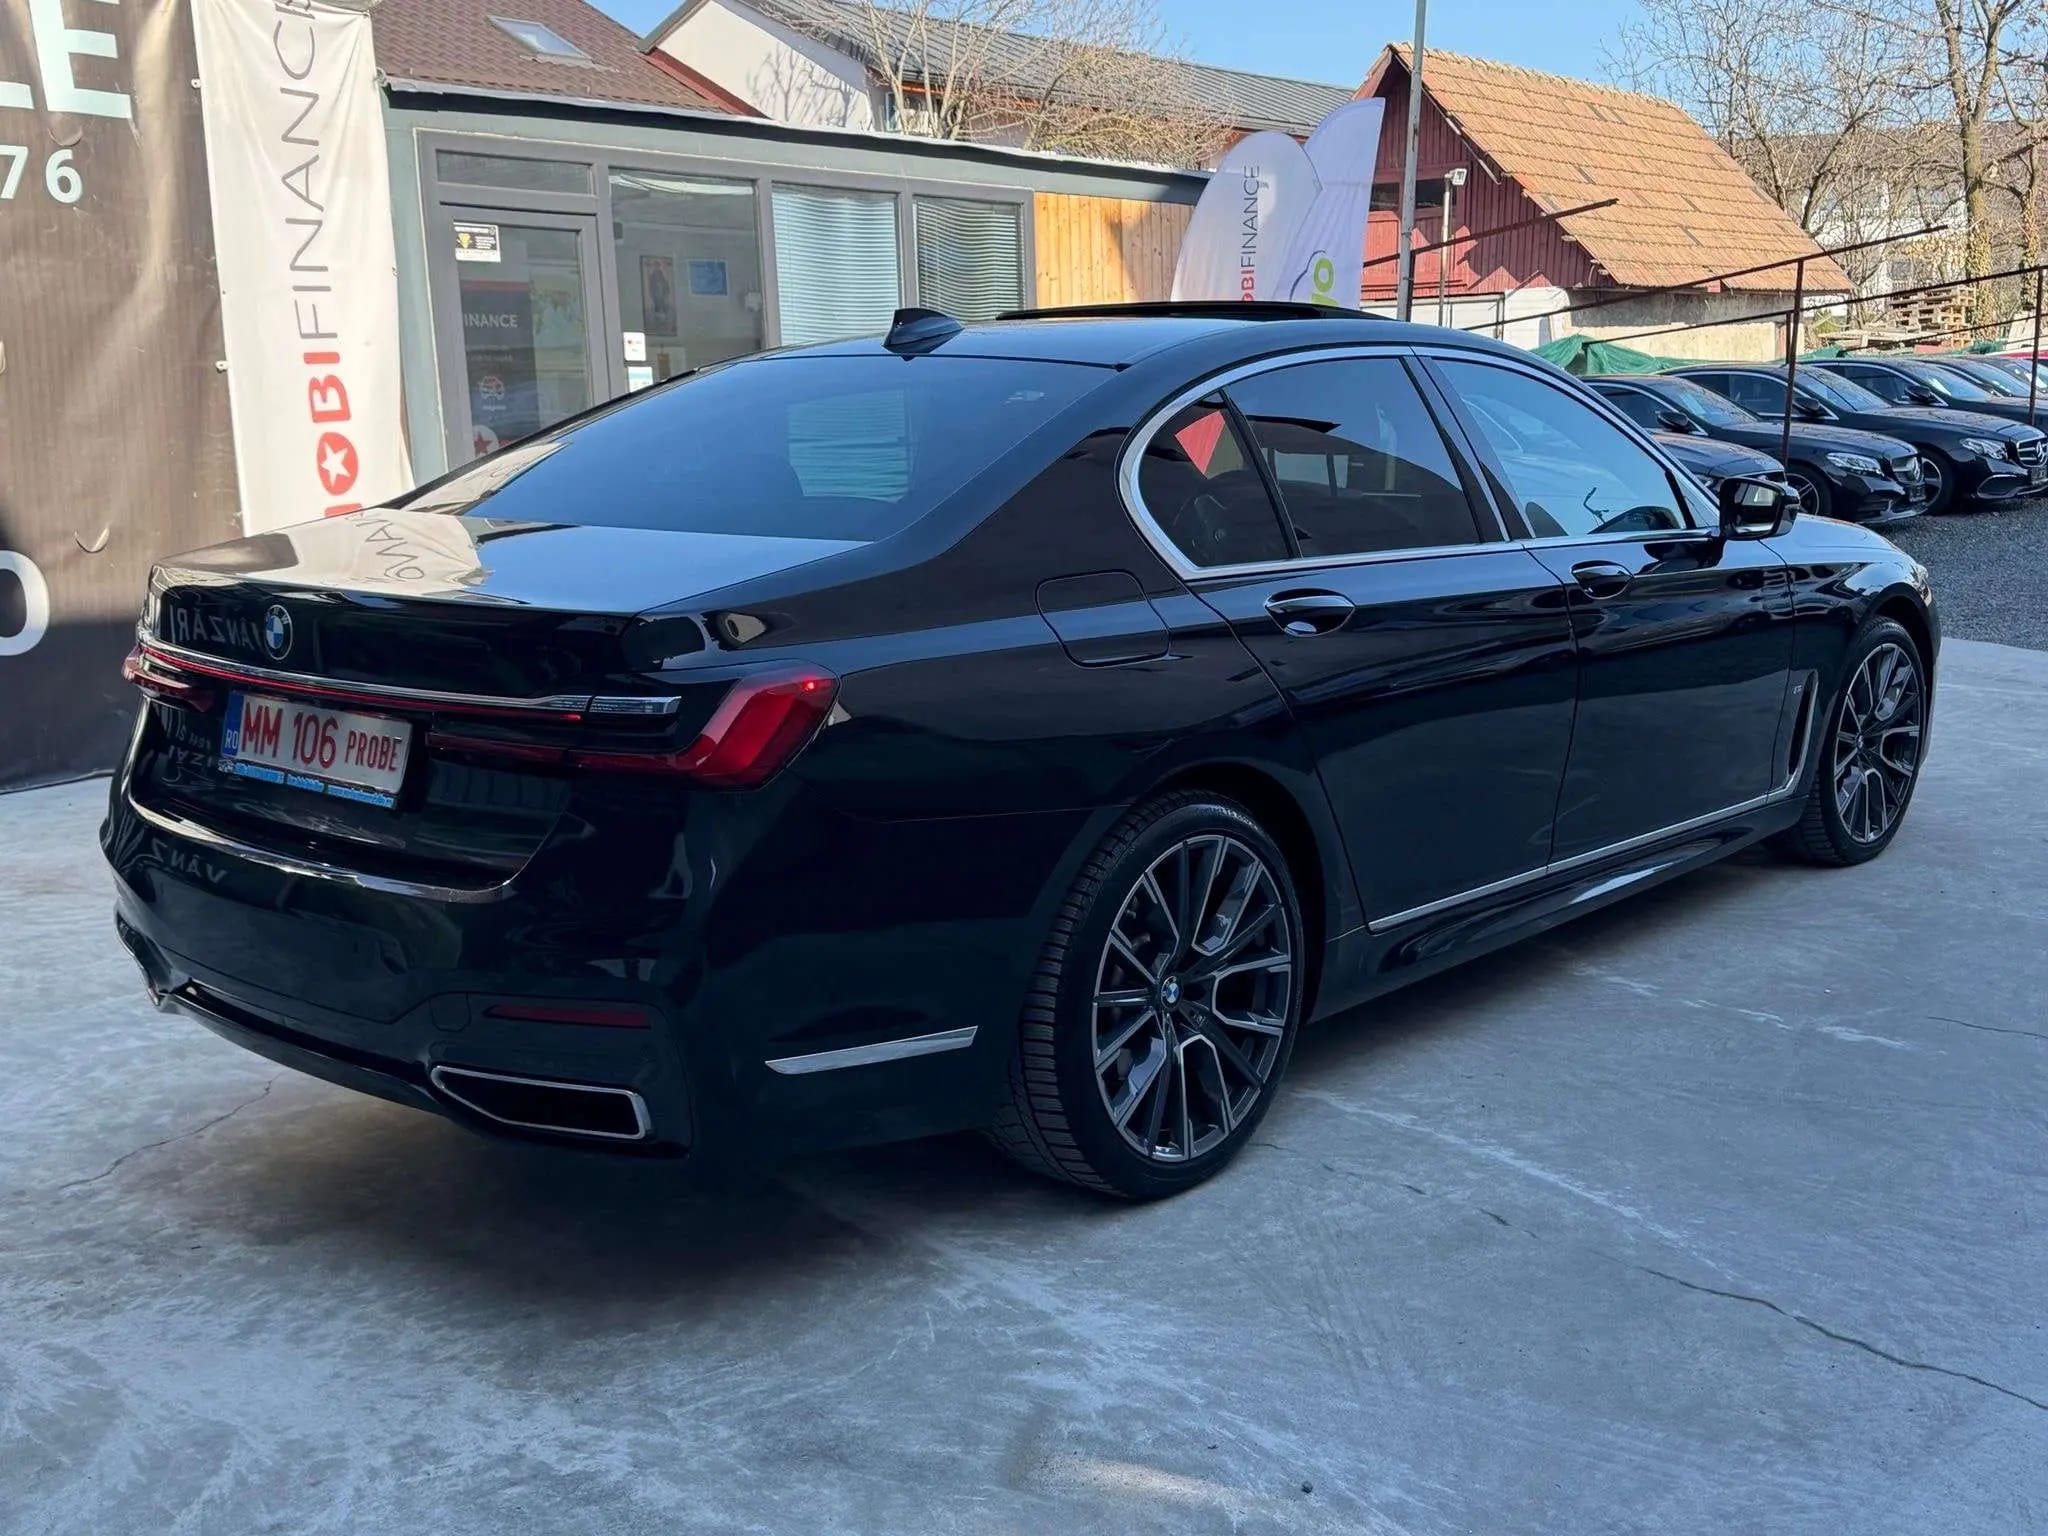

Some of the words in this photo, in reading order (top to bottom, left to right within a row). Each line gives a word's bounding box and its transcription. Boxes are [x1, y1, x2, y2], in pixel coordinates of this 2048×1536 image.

[0, 0, 133, 119] E
[224, 729, 239, 750] RO
[241, 701, 284, 759] MM
[292, 711, 339, 770] 106
[344, 729, 403, 772] PROBE
